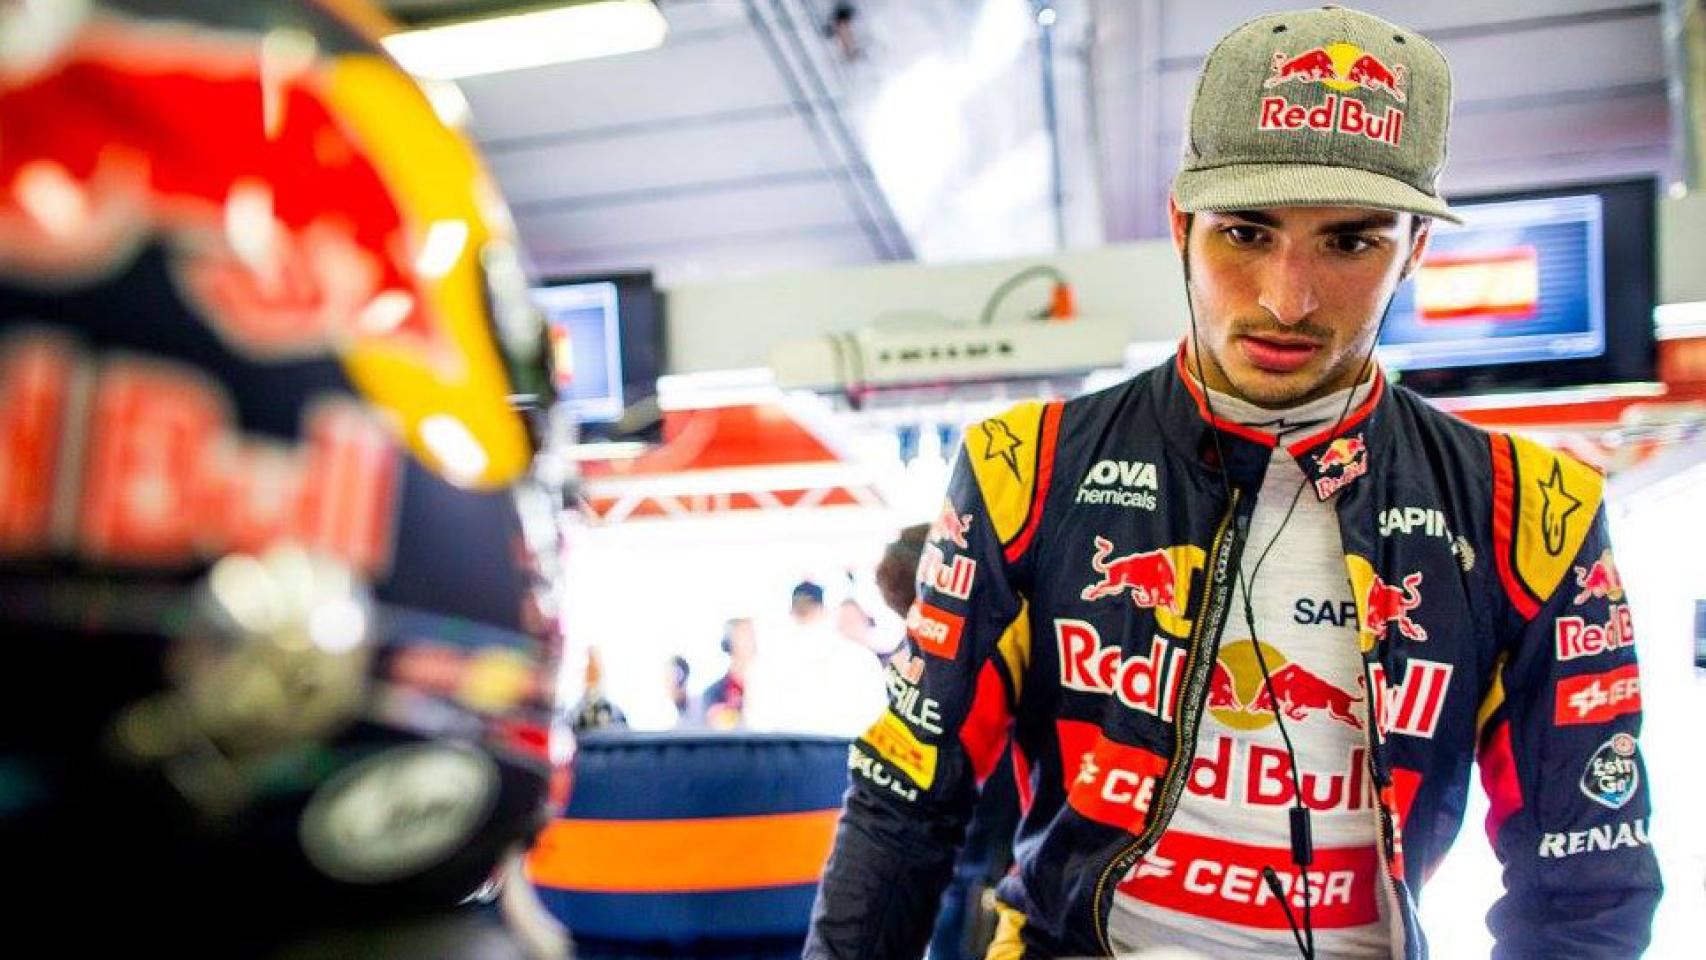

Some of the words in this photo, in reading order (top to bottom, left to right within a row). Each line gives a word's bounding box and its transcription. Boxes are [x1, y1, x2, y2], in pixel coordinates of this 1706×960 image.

[1260, 94, 1336, 131] Red
[1338, 97, 1404, 147] Bull
[1075, 484, 1156, 511] hemicals
[1084, 459, 1158, 490] OVA
[1555, 604, 1616, 661] Red
[1054, 618, 1168, 717] Red
[1101, 768, 1157, 814] CE
[1183, 859, 1354, 909] CEPSA
